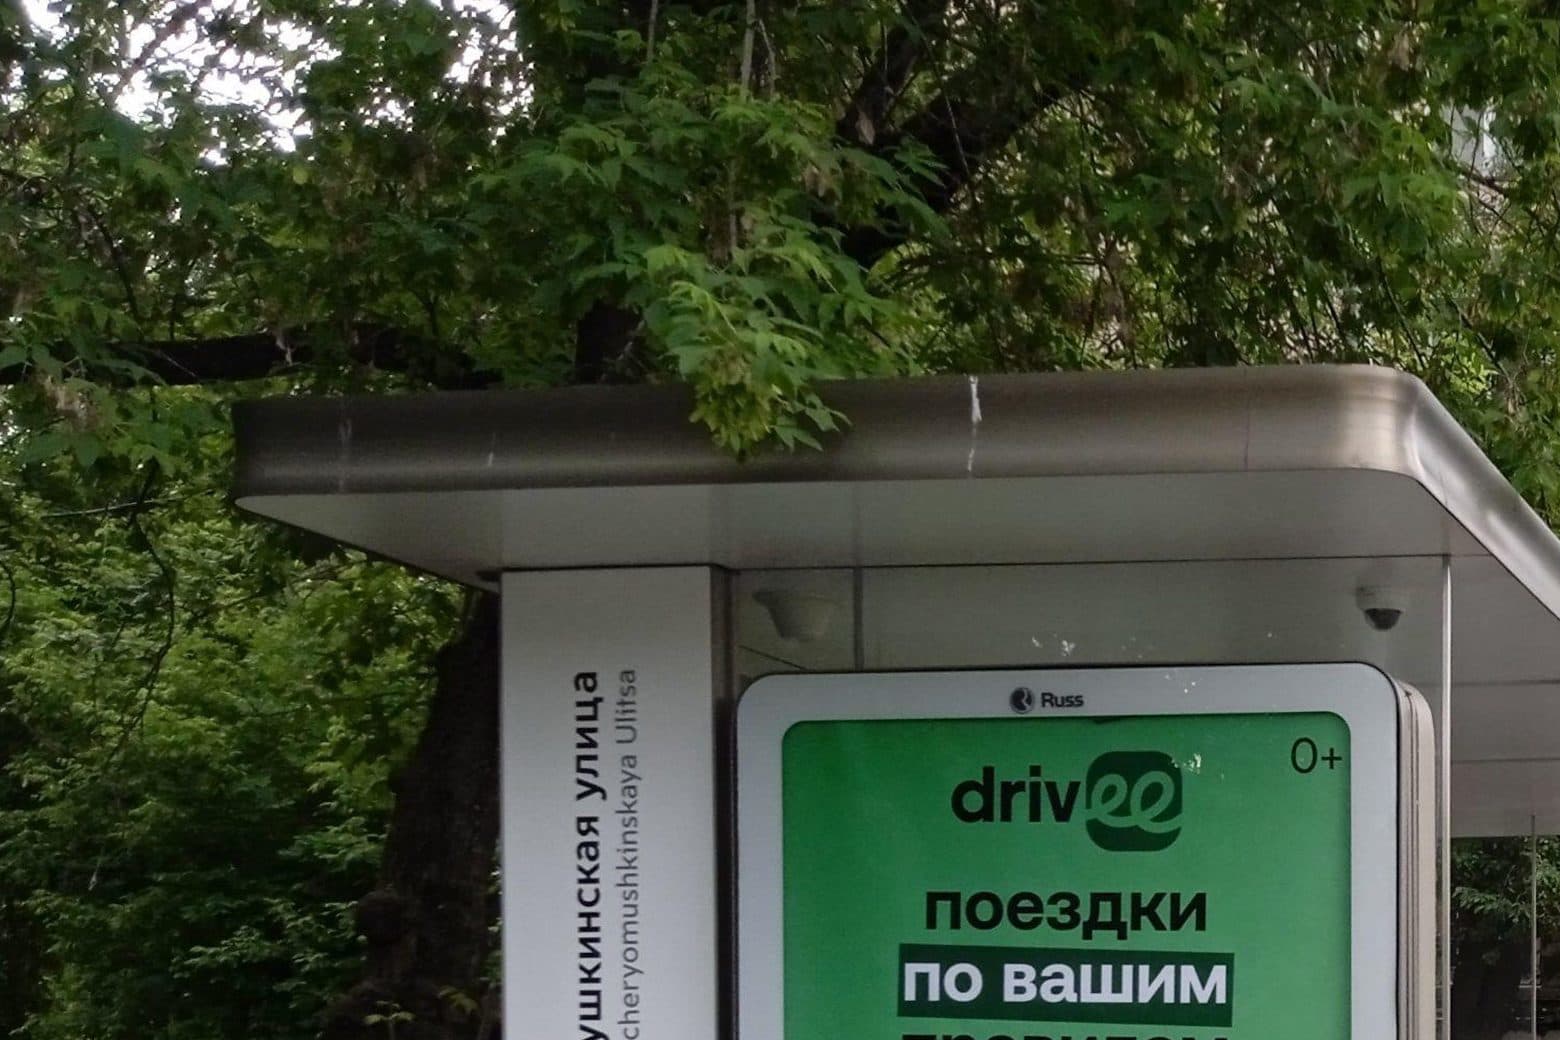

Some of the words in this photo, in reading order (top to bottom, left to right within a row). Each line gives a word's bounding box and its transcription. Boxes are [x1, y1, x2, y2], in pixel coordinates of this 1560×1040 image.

[616, 668, 638, 744] Ulitsa
[1041, 692, 1084, 708] Russ
[574, 670, 607, 800] улица
[1291, 737, 1342, 774] 0+
[951, 766, 1183, 834] drivee
[926, 891, 1207, 940] поездки
[904, 963, 982, 1001] по
[1003, 963, 1226, 1005] вашим
